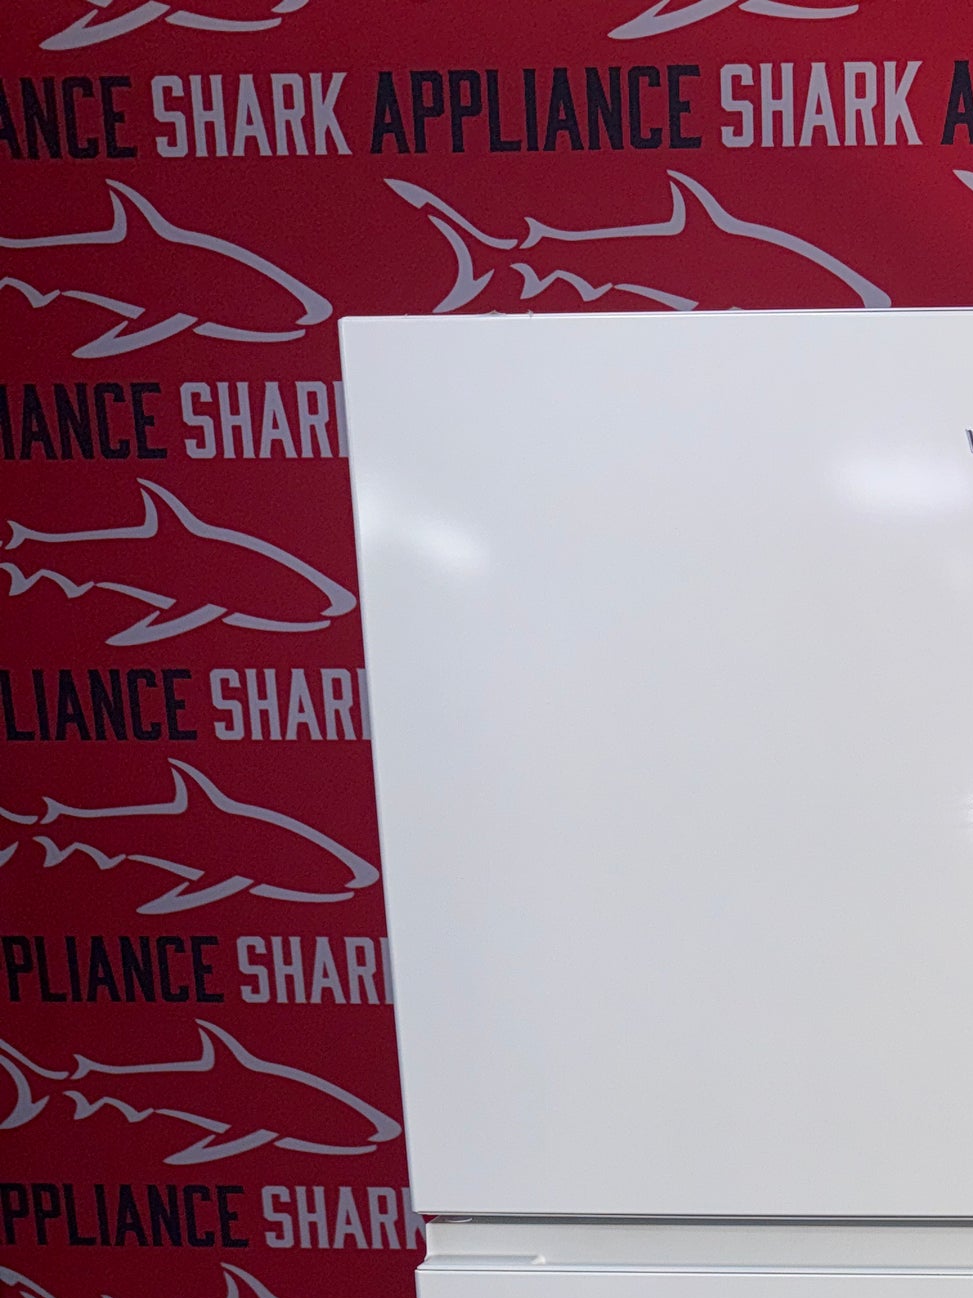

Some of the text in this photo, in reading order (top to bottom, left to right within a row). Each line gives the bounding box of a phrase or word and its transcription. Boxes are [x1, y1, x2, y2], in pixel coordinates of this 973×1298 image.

[151, 72, 352, 158] SHARK
[370, 64, 702, 154] APPLIANCE
[719, 60, 923, 148] SHARK
